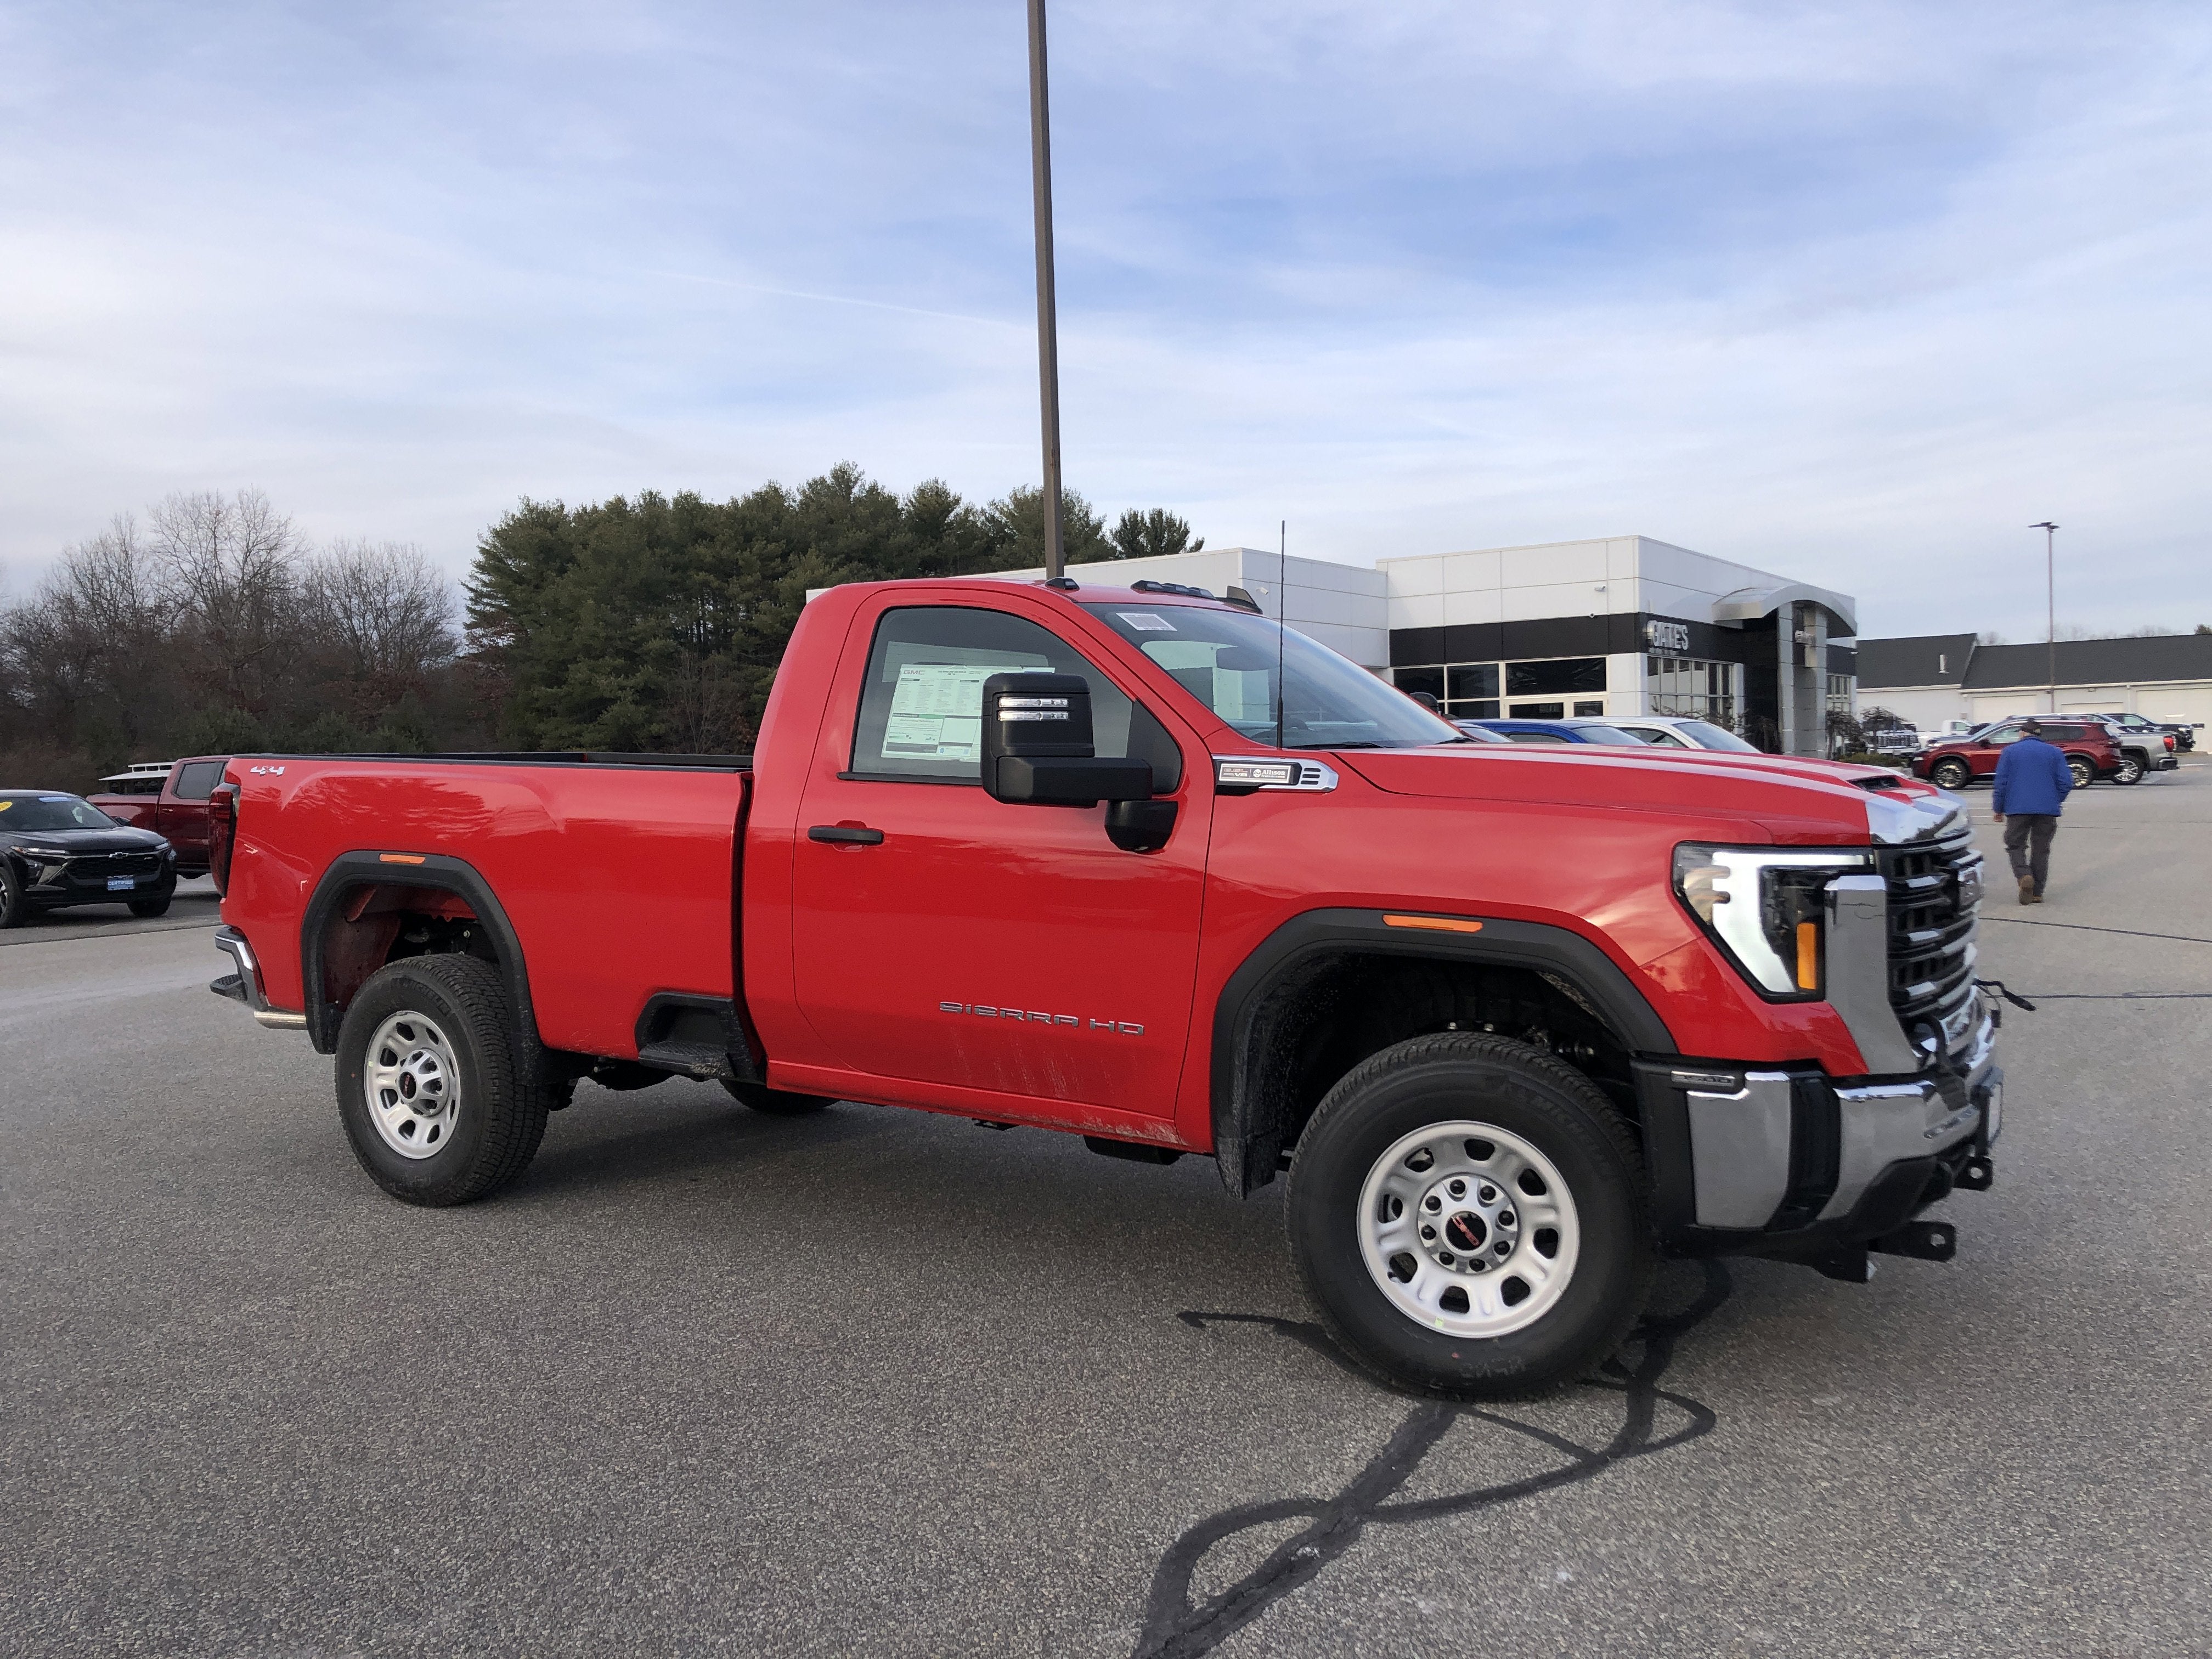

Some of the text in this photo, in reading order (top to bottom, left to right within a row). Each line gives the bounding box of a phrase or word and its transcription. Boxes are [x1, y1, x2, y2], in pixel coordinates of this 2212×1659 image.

[1647, 620, 1689, 650] GATES
[939, 1001, 1145, 1036] SIERRA HD
[1451, 1216, 1480, 1246] GMC
